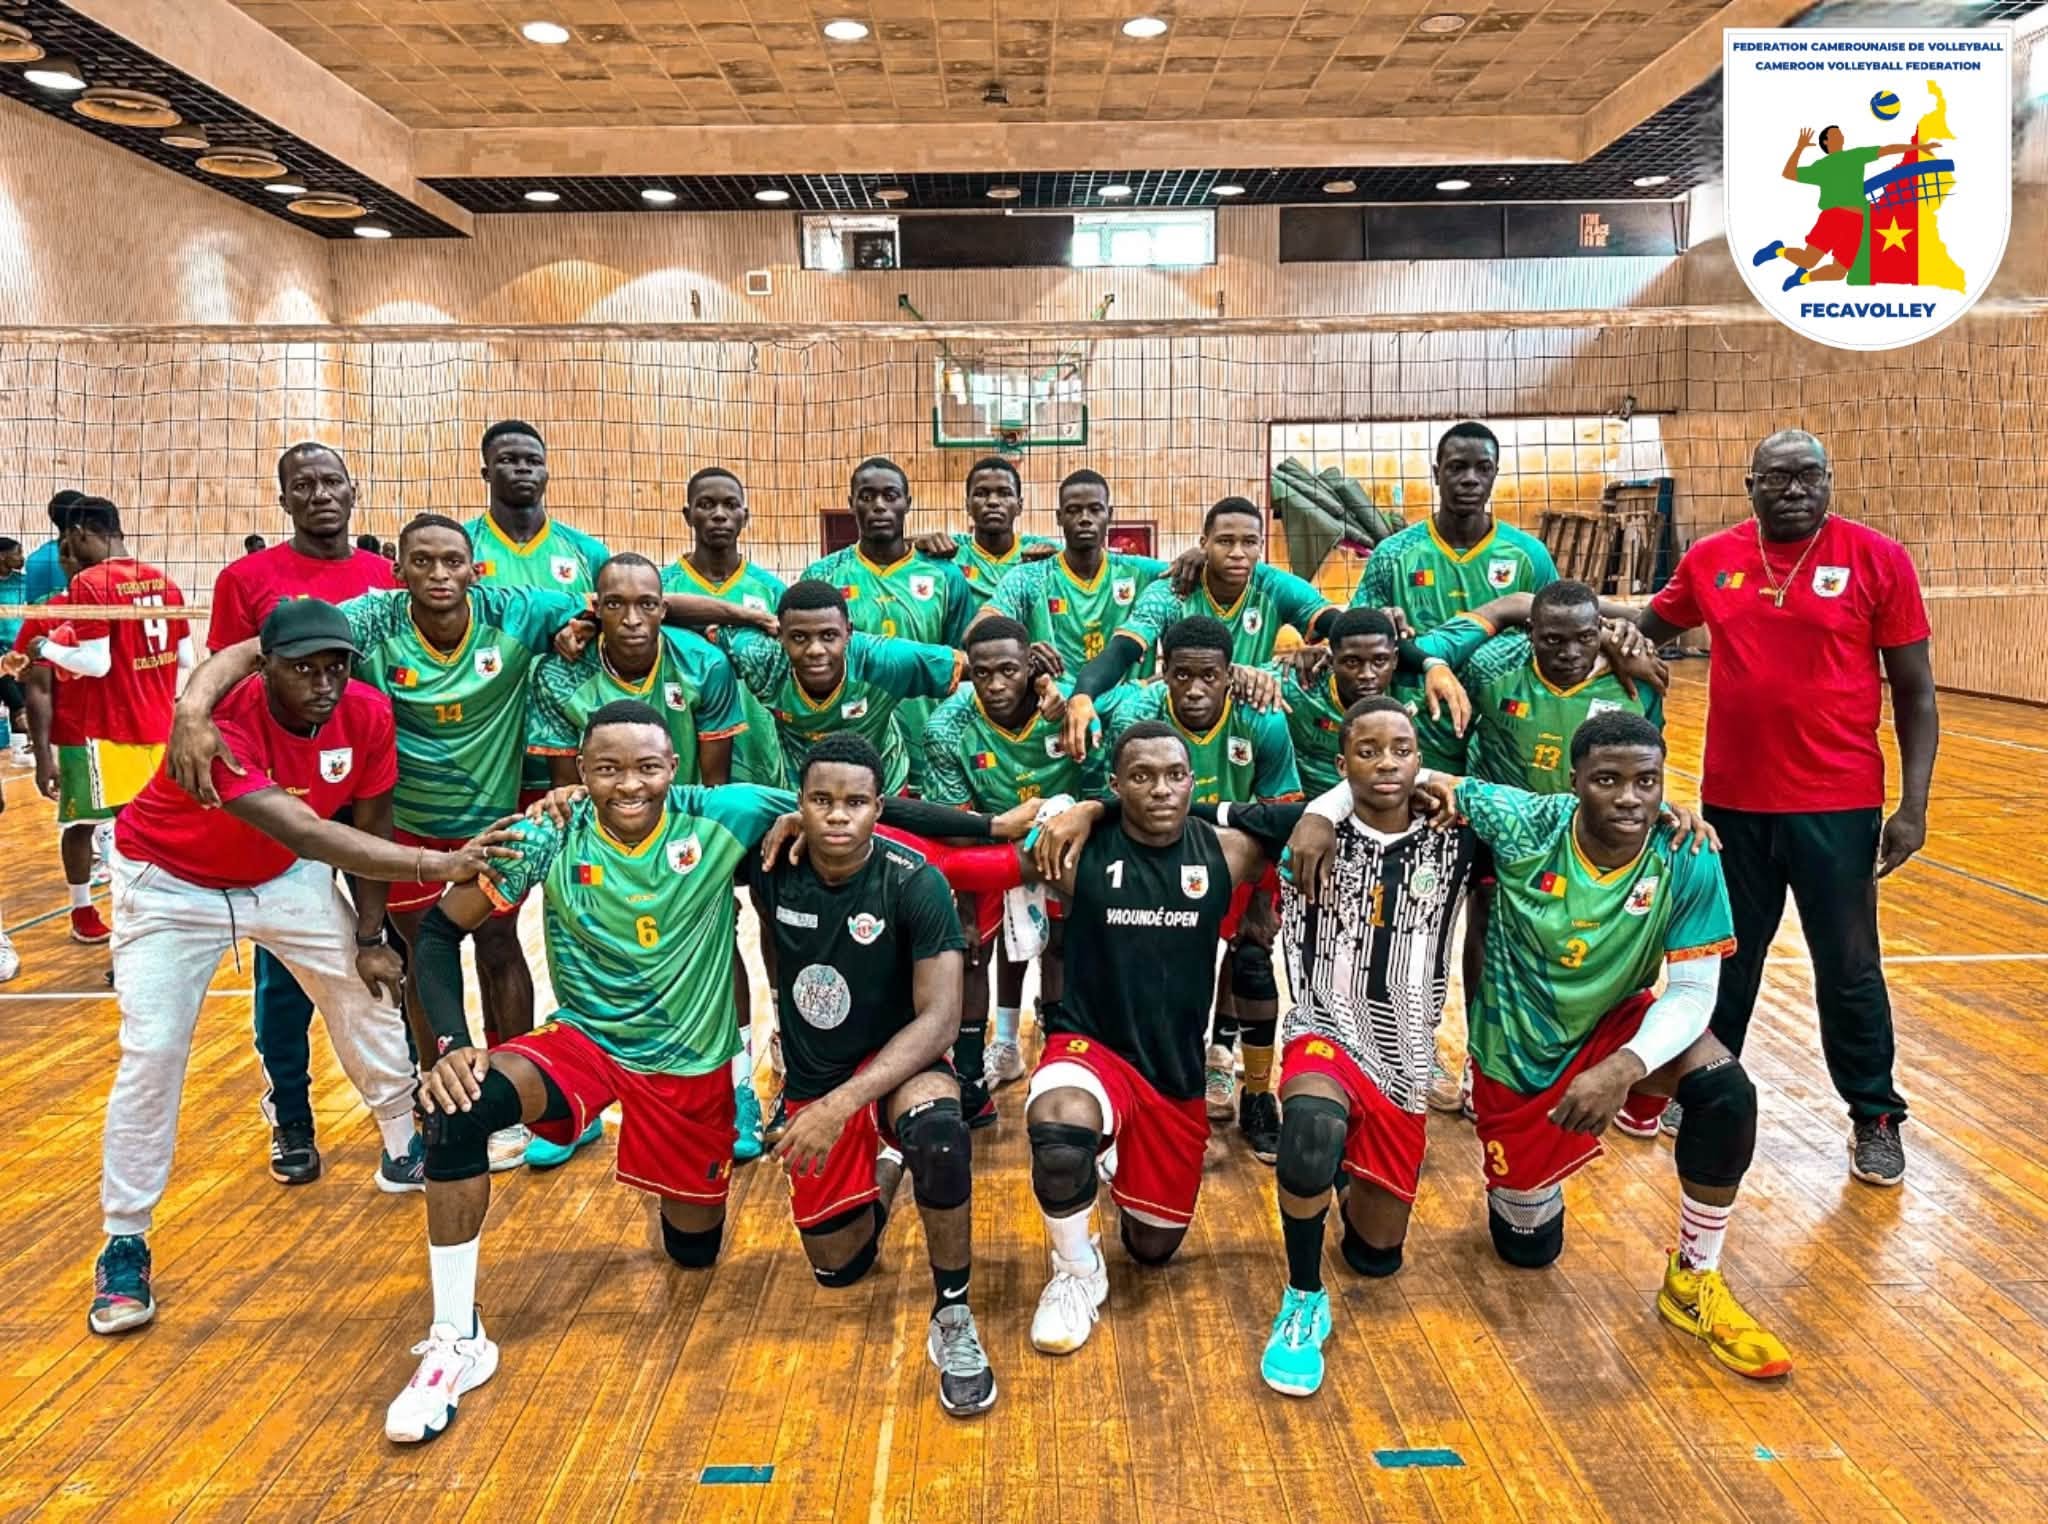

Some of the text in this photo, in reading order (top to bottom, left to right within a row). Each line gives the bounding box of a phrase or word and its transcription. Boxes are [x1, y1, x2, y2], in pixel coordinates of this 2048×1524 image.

[434, 702, 463, 723] 14
[1106, 860, 1124, 889] 1
[1106, 906, 1199, 927] YAOUNDÉ OPEN
[1368, 882, 1385, 928] 1
[635, 915, 660, 948] 6
[1560, 937, 1588, 969] 3
[1066, 1039, 1089, 1054] 9
[1486, 1140, 1509, 1176] 3
